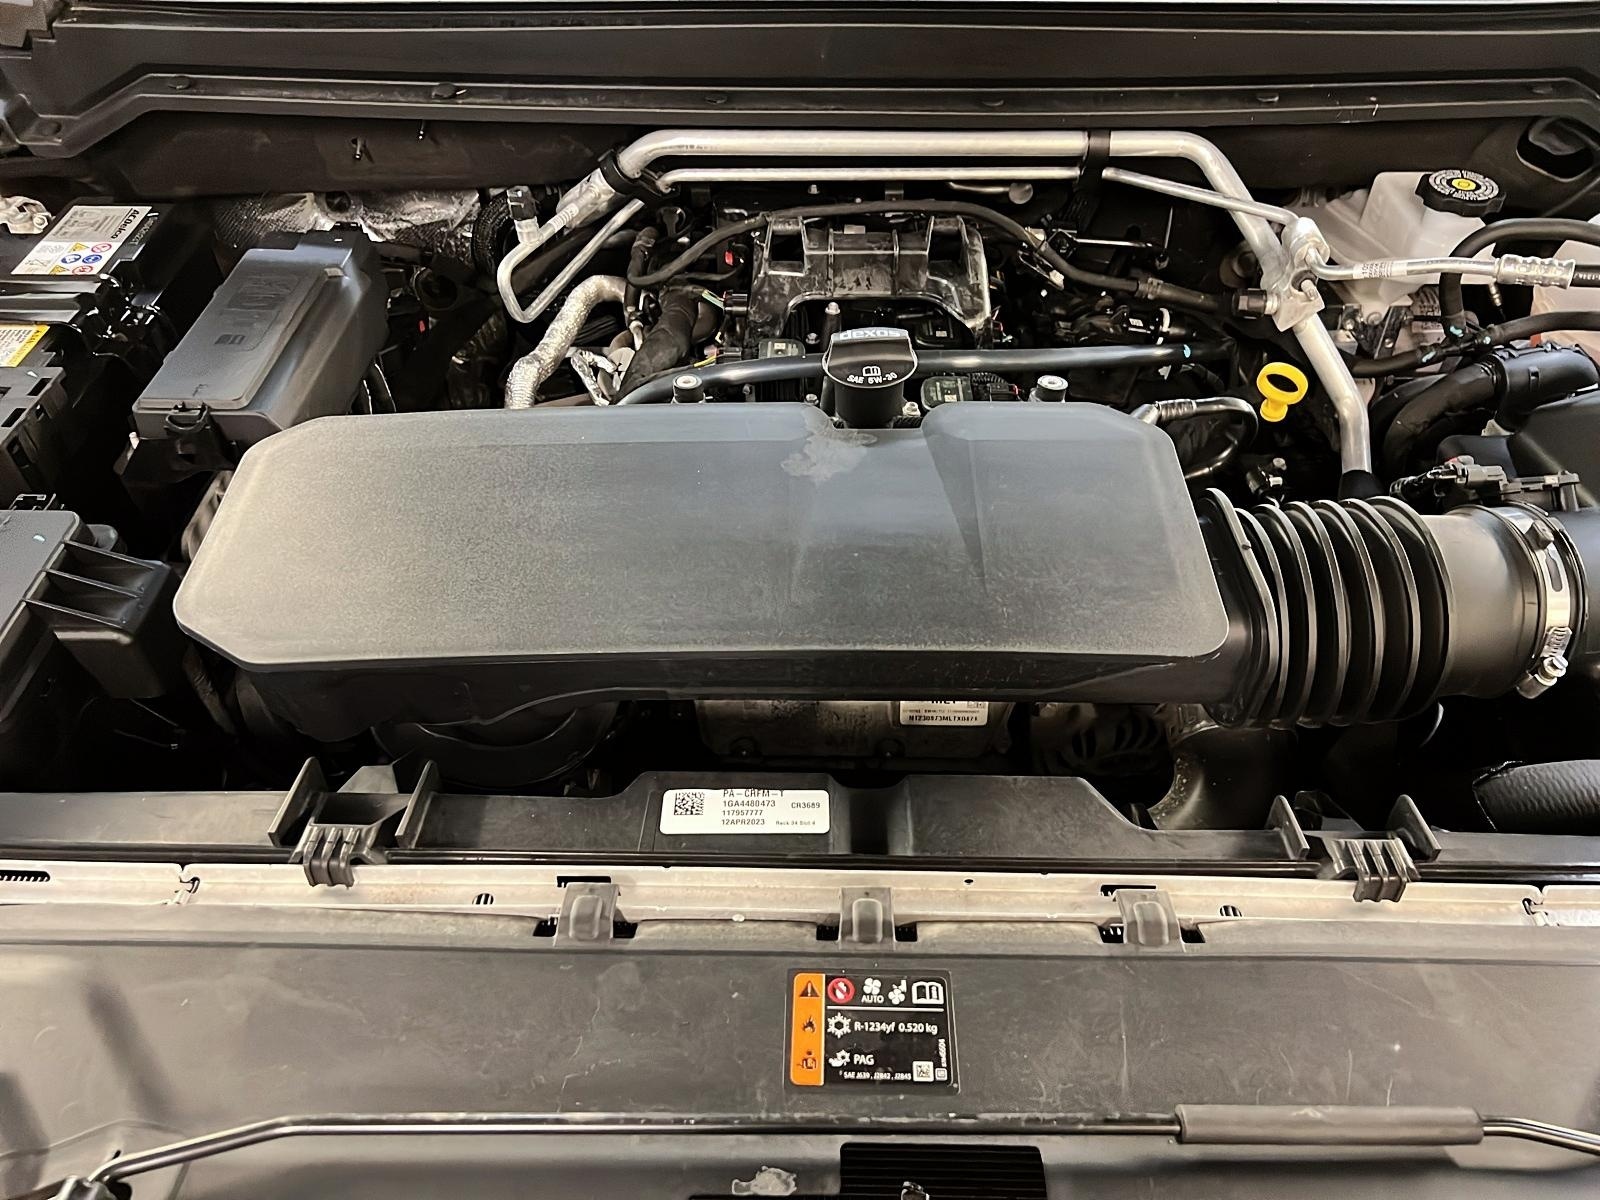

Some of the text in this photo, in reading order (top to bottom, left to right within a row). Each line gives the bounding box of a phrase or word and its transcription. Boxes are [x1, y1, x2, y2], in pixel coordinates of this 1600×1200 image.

[111, 209, 140, 239] ACDelco
[840, 329, 901, 339] dexos
[847, 372, 898, 384] SAE 5W-30
[861, 995, 884, 1003] AUTO
[854, 1021, 938, 1035] R-1234yf 0.520 kg
[853, 1054, 875, 1065] PAG
[844, 1071, 855, 1079] SAE
